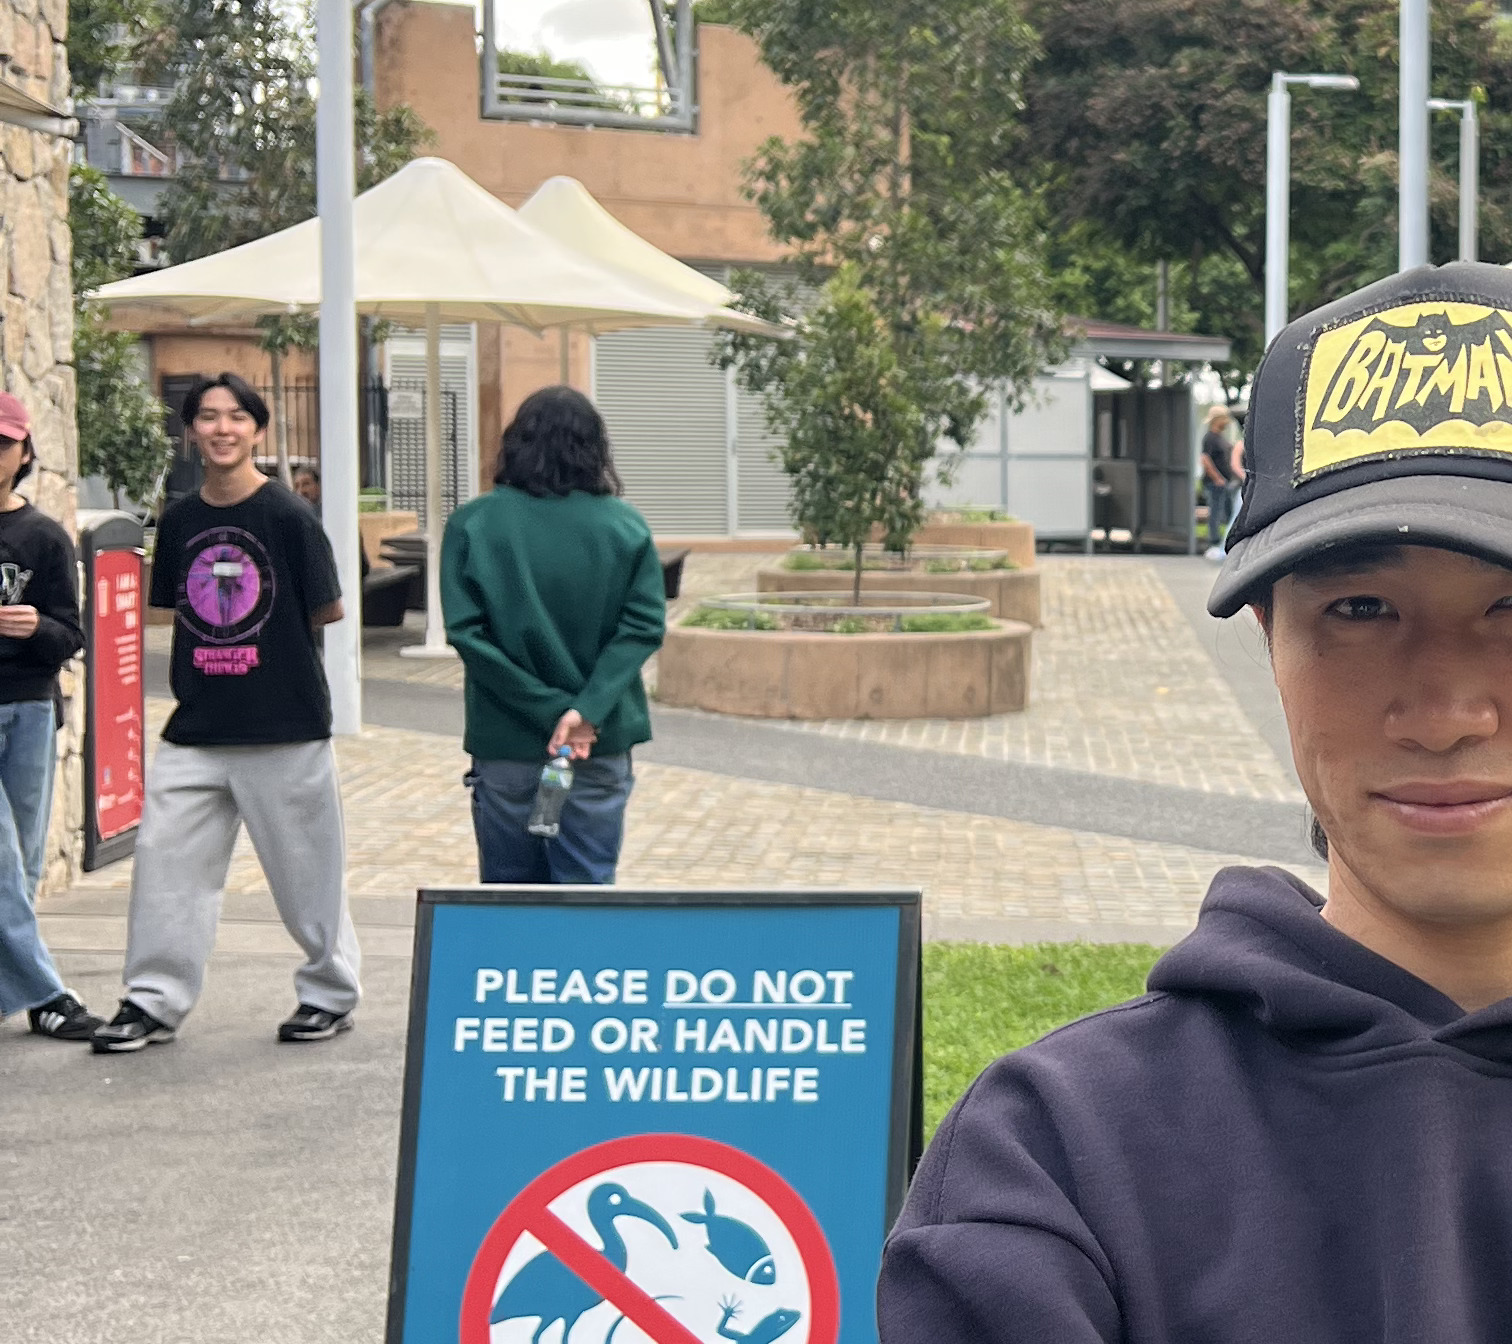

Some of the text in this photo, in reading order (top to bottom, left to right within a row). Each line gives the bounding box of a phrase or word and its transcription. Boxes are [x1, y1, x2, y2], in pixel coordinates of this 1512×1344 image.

[475, 968, 854, 1004] PLEASE DO NOT
[454, 1017, 867, 1054] FEED OR HANDLE
[496, 1067, 819, 1103] THE WILDLIFE
